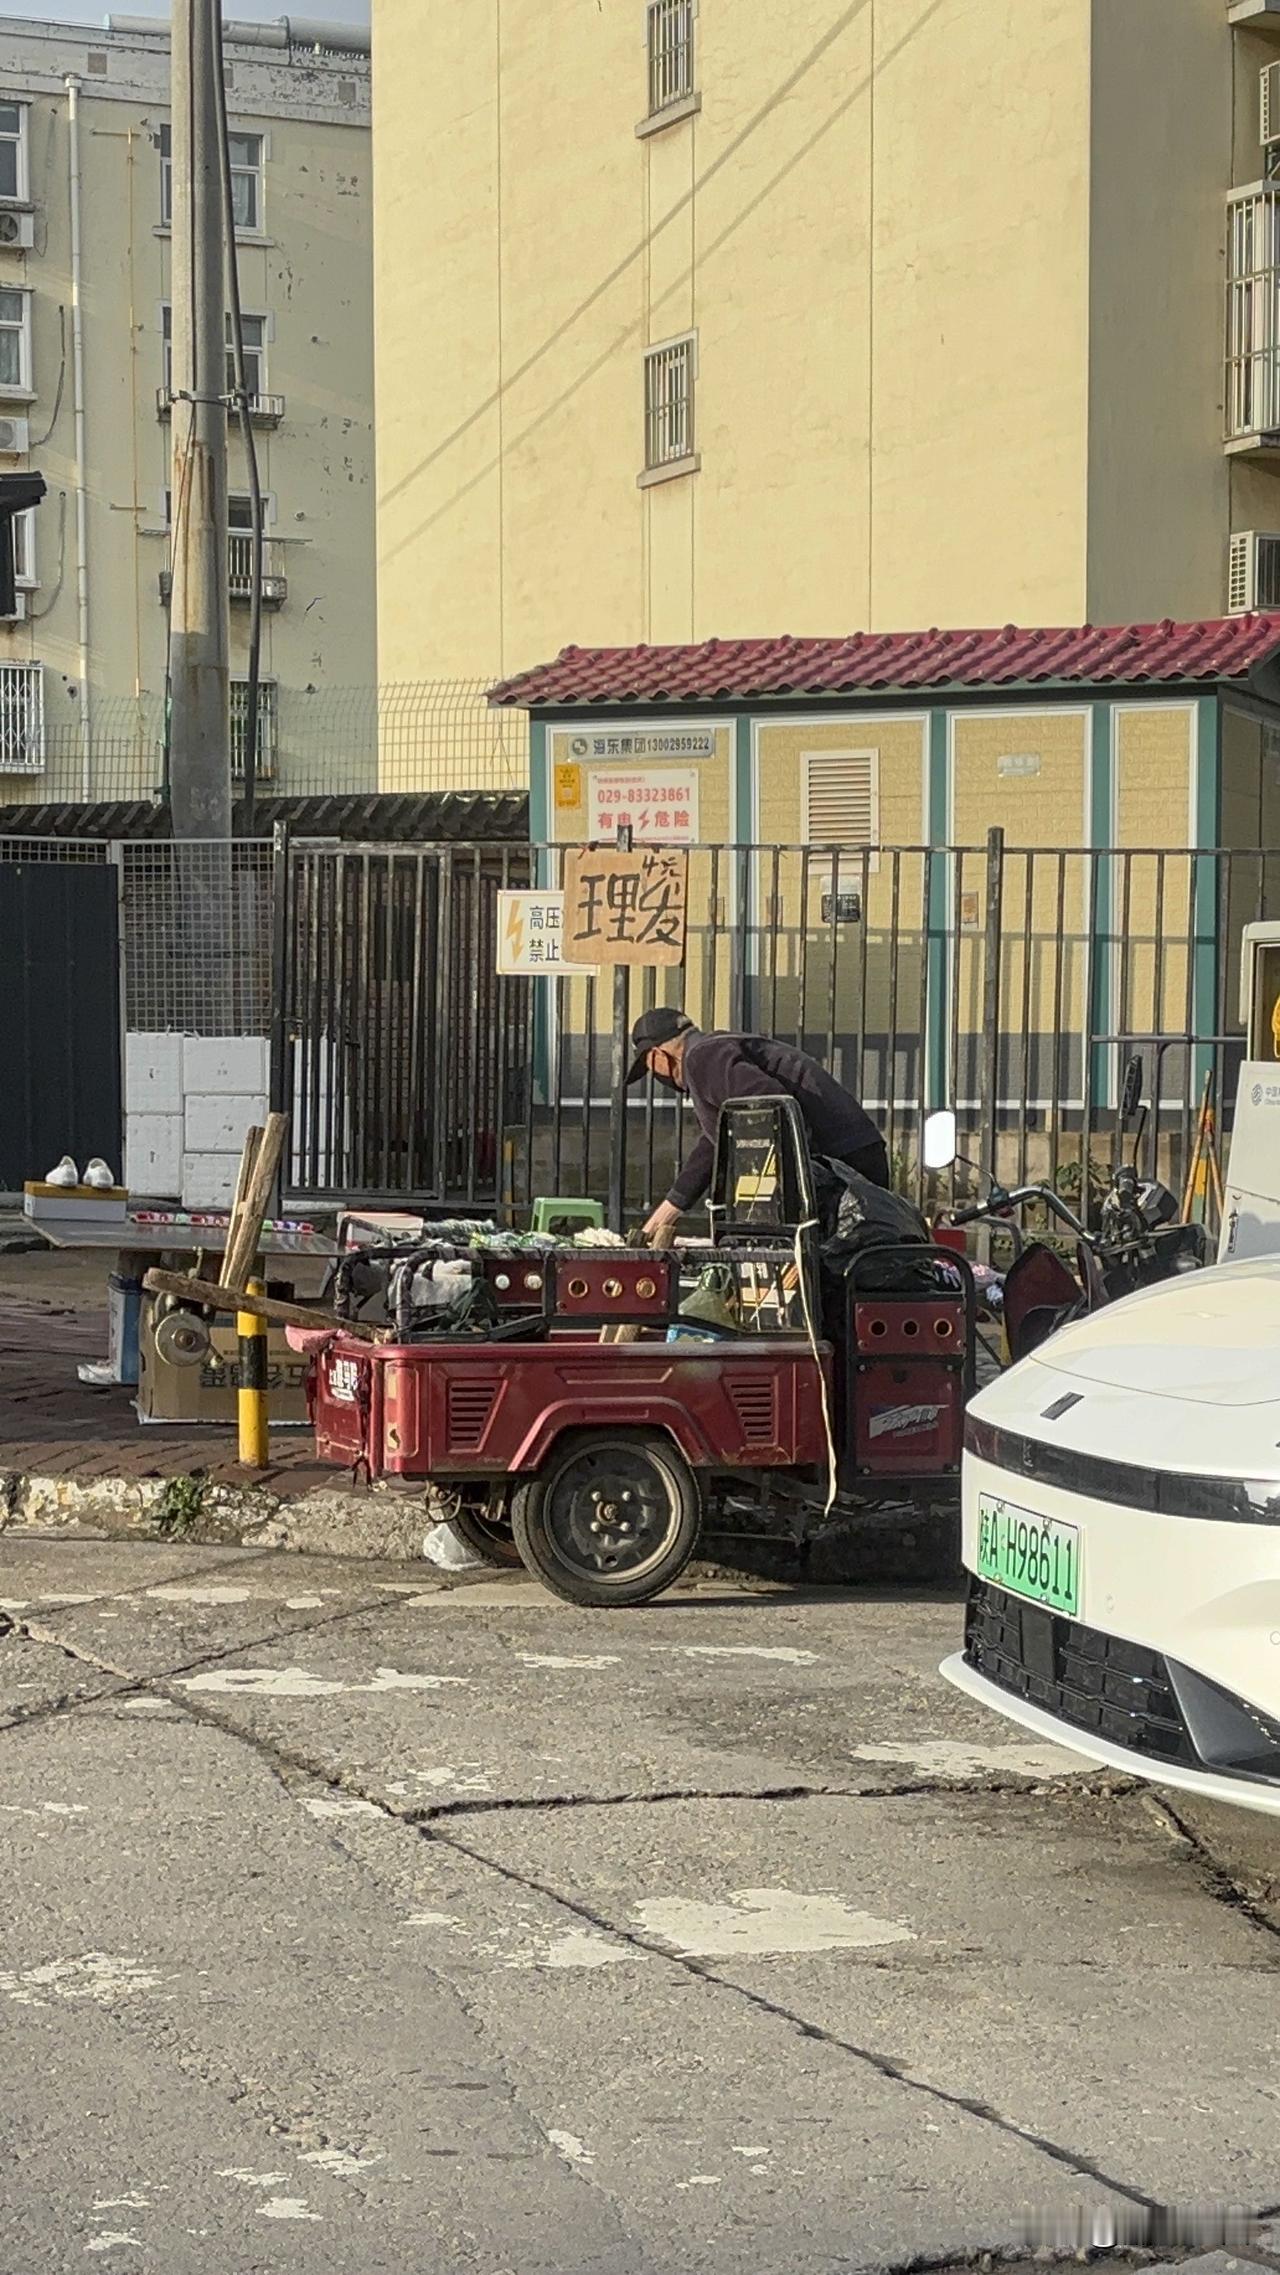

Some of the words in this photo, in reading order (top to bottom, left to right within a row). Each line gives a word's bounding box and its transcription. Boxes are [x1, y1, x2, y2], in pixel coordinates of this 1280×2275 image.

[597, 787, 691, 803] 029-83323861
[655, 810, 690, 828] 危险
[529, 905, 565, 930] 高压
[529, 938, 560, 962] 禁止
